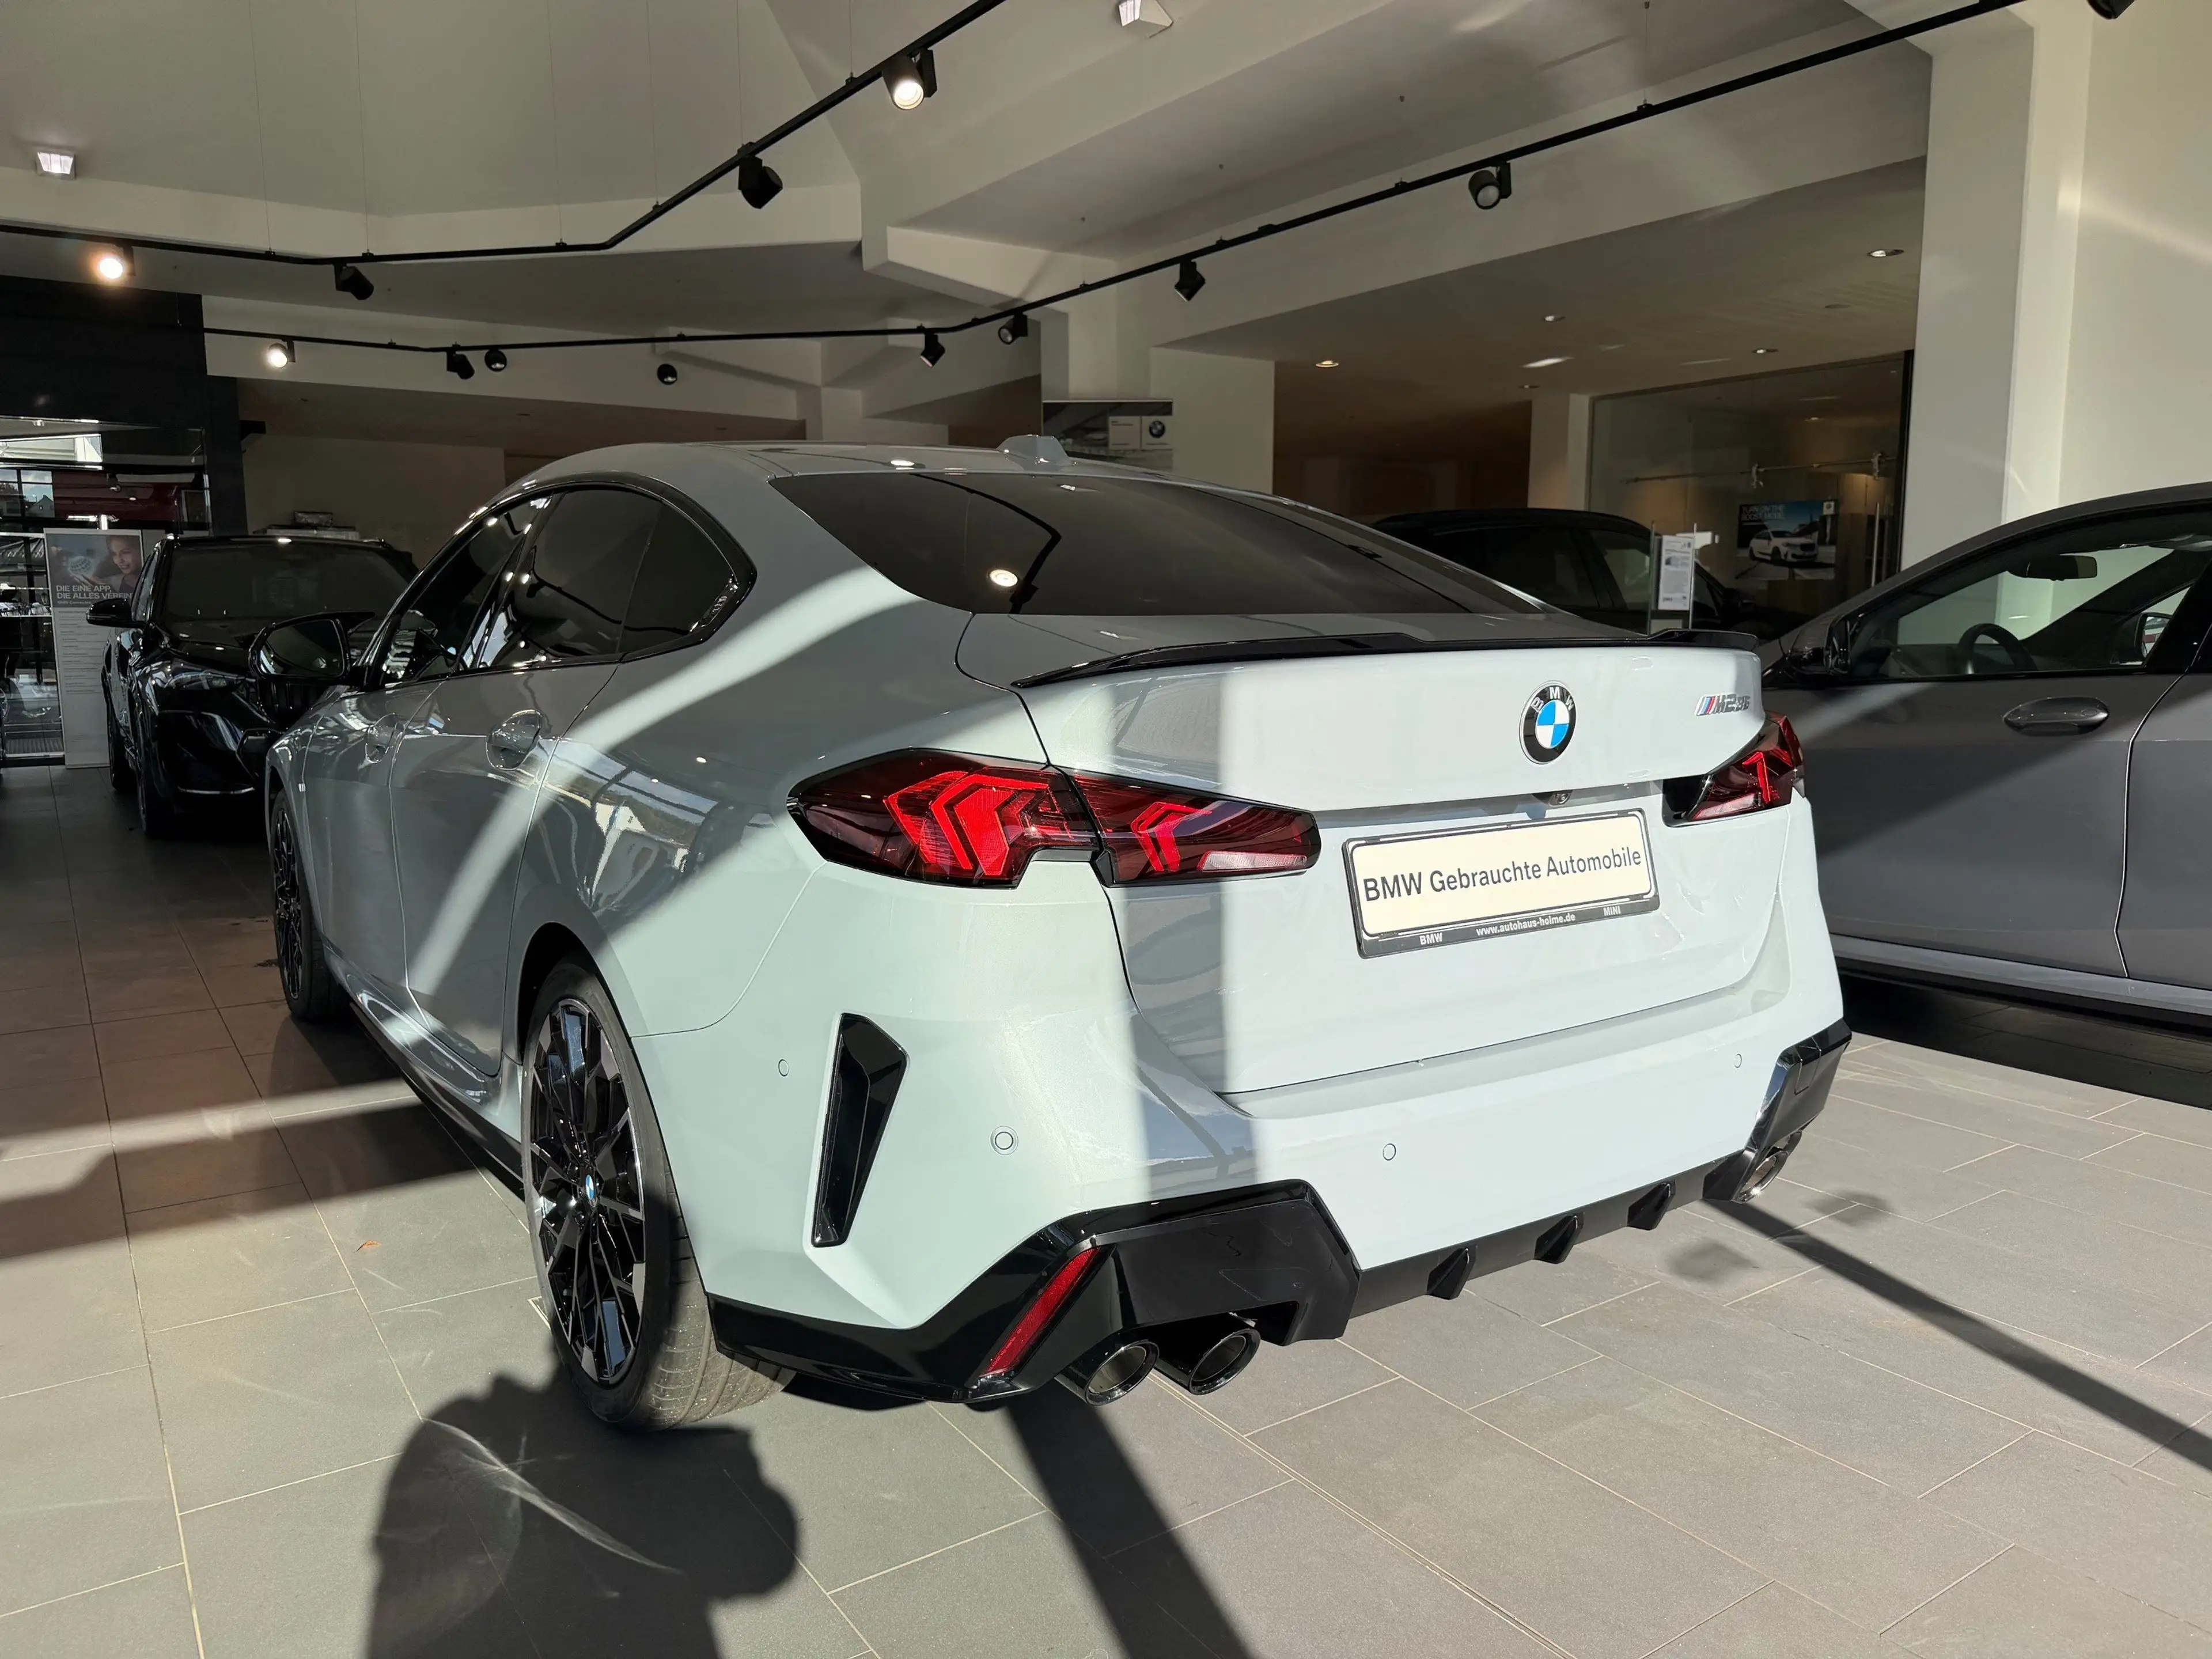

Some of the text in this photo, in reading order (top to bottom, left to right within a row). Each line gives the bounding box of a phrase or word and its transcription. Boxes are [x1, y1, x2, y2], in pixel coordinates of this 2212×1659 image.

[93, 585, 112, 593] APP,
[1530, 686, 1574, 713] BMW
[1363, 846, 1641, 902] BMW Gebrauchte Automobile
[1419, 905, 1622, 945] BMW www.autohaus-holme.de MINI
